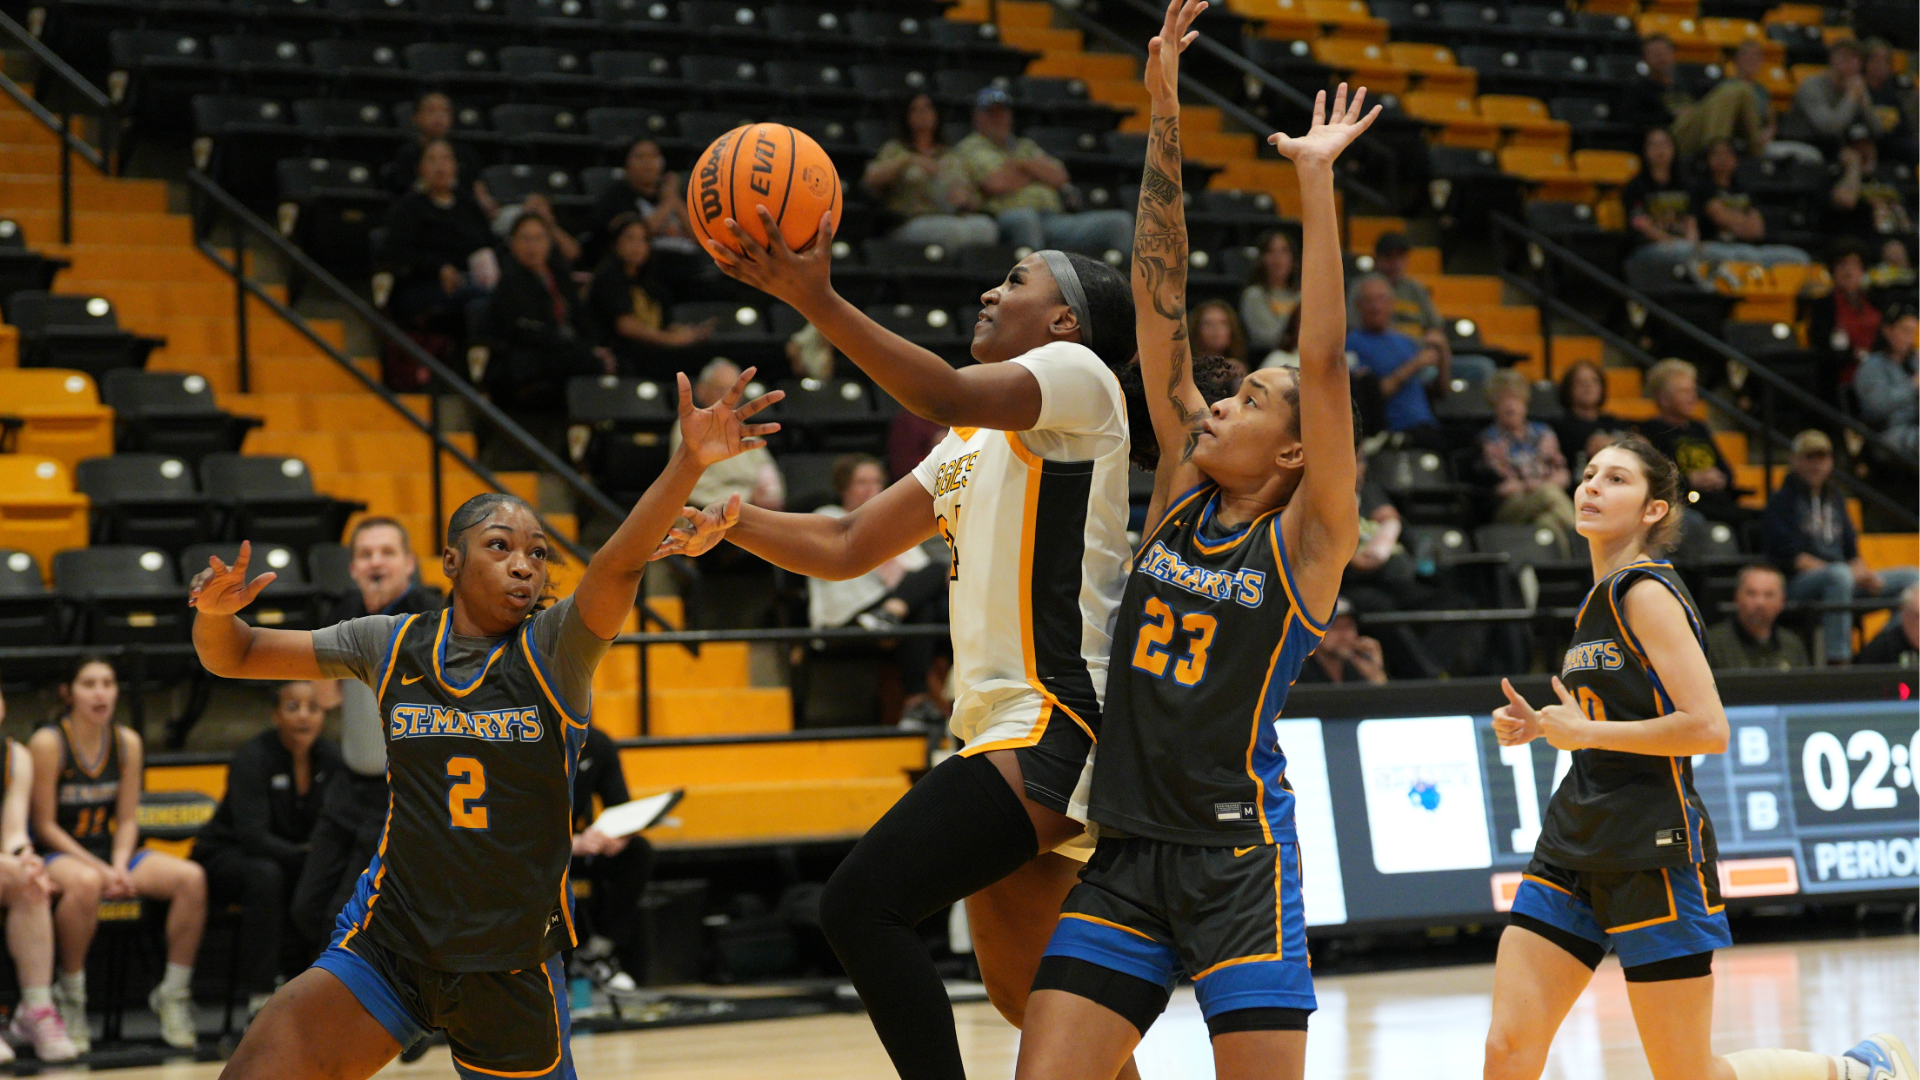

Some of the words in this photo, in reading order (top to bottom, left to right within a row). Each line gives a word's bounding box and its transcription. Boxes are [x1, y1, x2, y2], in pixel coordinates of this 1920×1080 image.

[1131, 594, 1219, 688] 23
[391, 703, 544, 742] ST.MARY'S
[1738, 726, 1770, 766] B
[1802, 729, 1919, 811] 02:
[445, 755, 490, 831] 2
[1244, 806, 1254, 816] M
[1747, 791, 1778, 831] B
[1676, 832, 1683, 840] L
[551, 914, 559, 924] M
